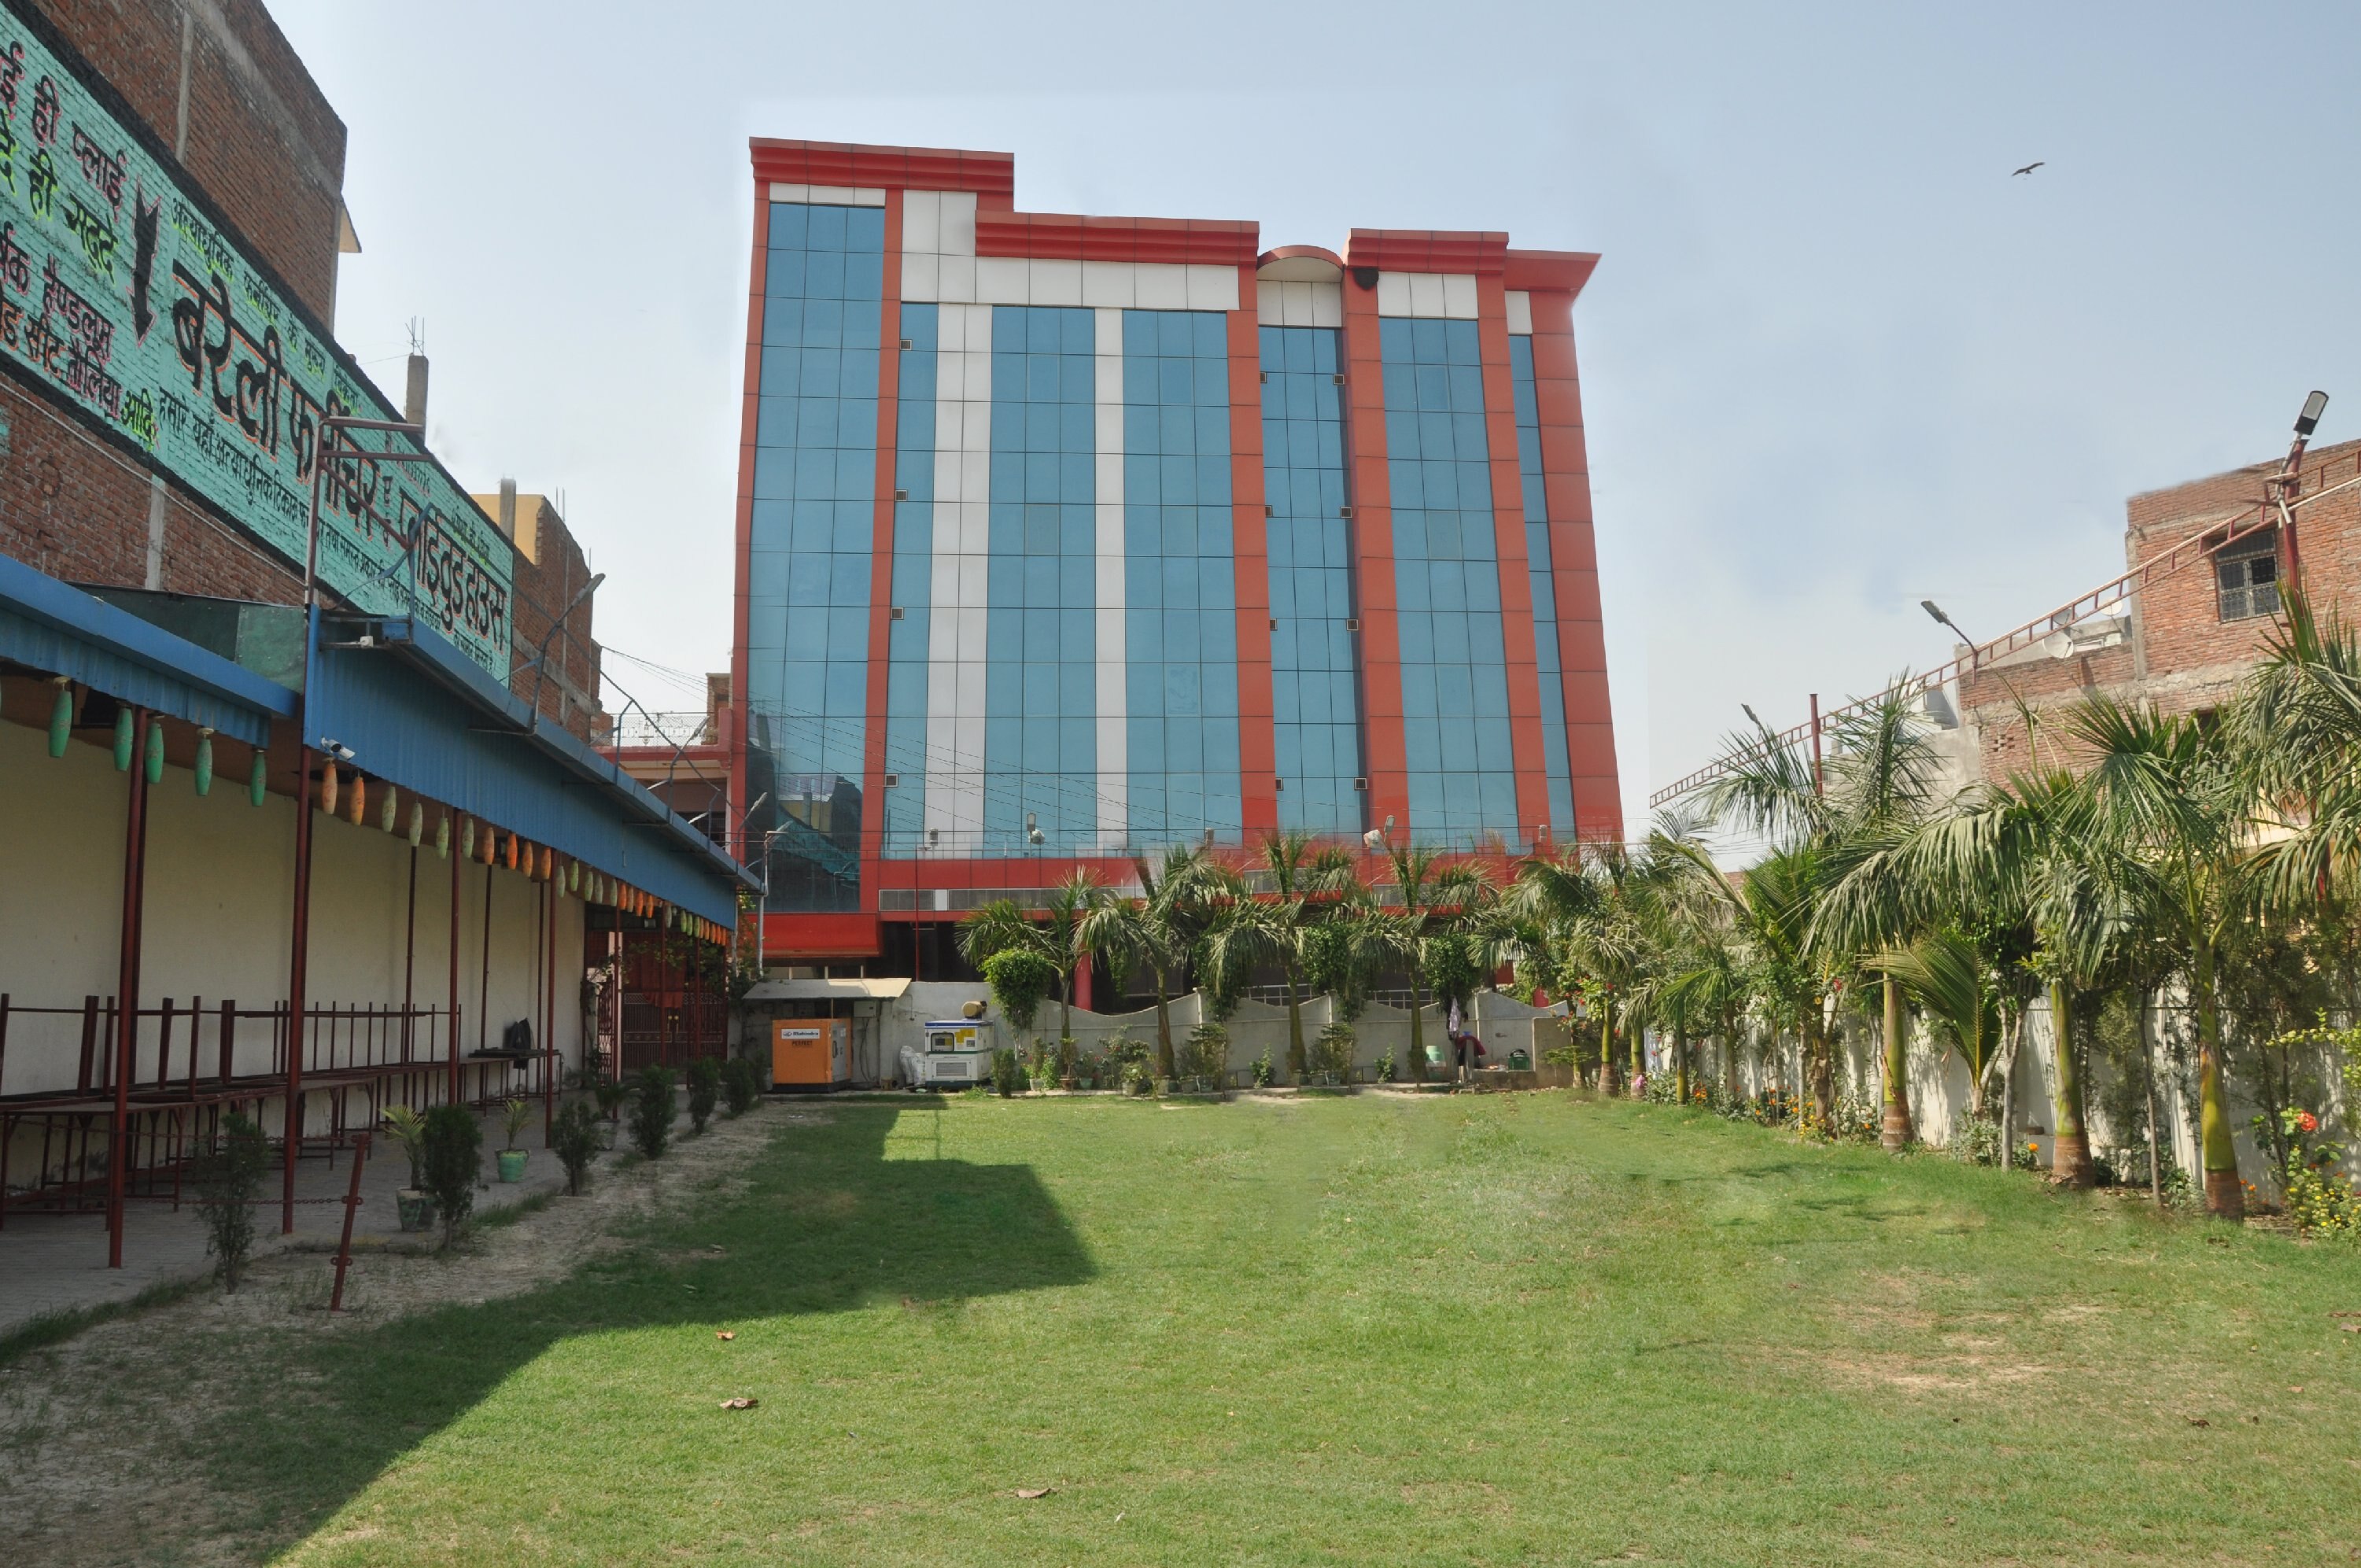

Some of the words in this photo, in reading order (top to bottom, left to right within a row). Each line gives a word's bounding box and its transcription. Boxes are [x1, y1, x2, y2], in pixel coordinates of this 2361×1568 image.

[29, 148, 57, 220] ही
[32, 75, 61, 146] ही
[72, 120, 127, 222] प्लाई
[24, 312, 66, 378] सीट
[68, 334, 122, 419] तौलिया
[172, 258, 288, 464] बरेली
[466, 555, 508, 655] हाउस
